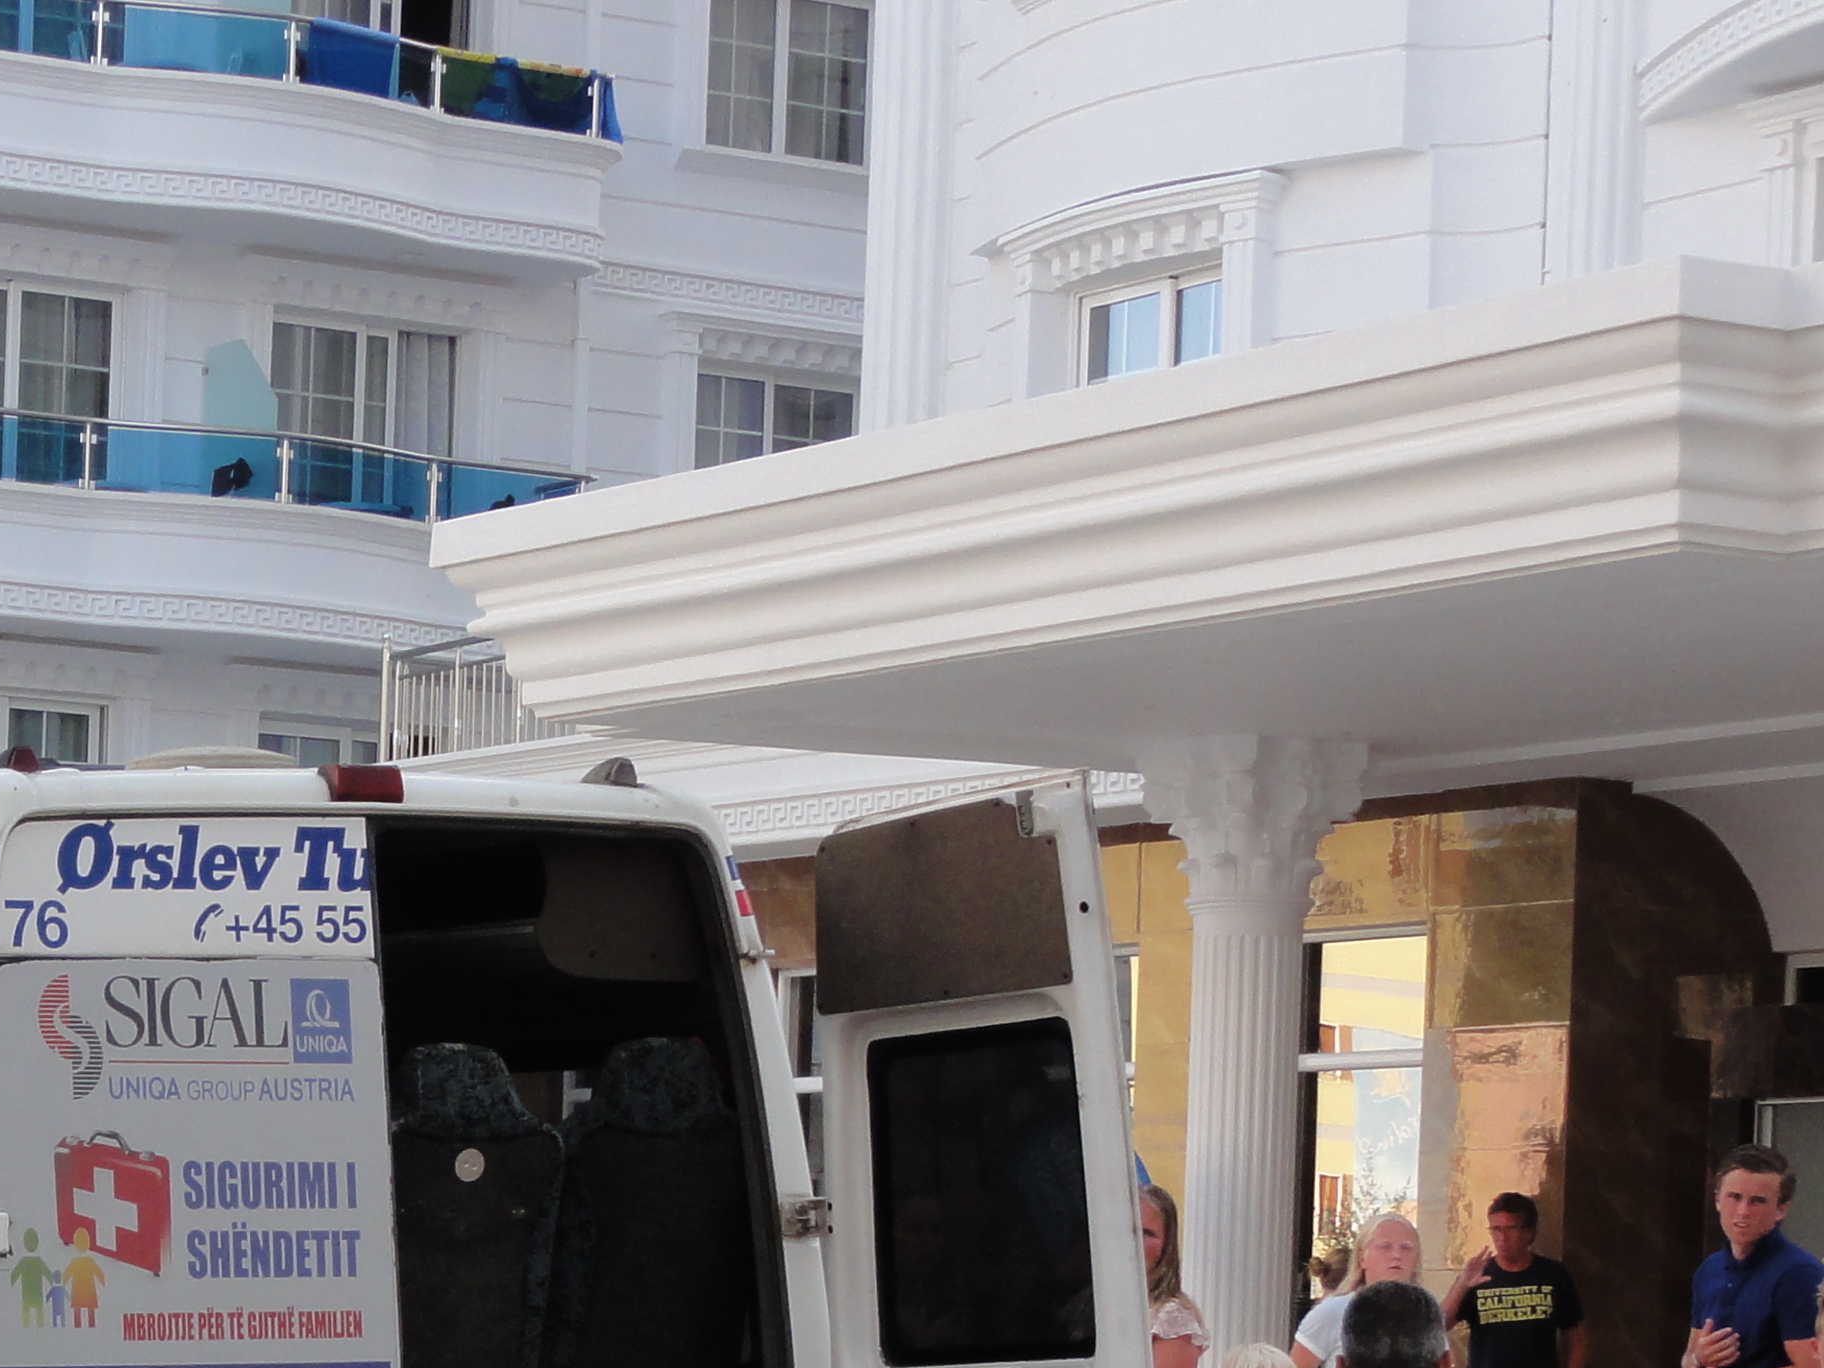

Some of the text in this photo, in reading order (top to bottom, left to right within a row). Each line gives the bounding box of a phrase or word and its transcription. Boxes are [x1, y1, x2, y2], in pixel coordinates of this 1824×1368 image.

[56, 820, 280, 894] Ørslev
[3, 899, 69, 949] 76
[225, 904, 367, 944] +45 55
[103, 974, 290, 1049] SIGAL
[295, 1034, 349, 1055] UNIQA
[108, 1076, 355, 1102] UNIQA GROUP AUSTRIA
[182, 1159, 357, 1210] SIGURIMI I
[186, 1222, 361, 1280] SHËNDETIT
[122, 1306, 363, 1341] MBROJTJE PËR TË GJITHË FAMILJEN
[1477, 1294, 1552, 1311] CALIFORNIA
